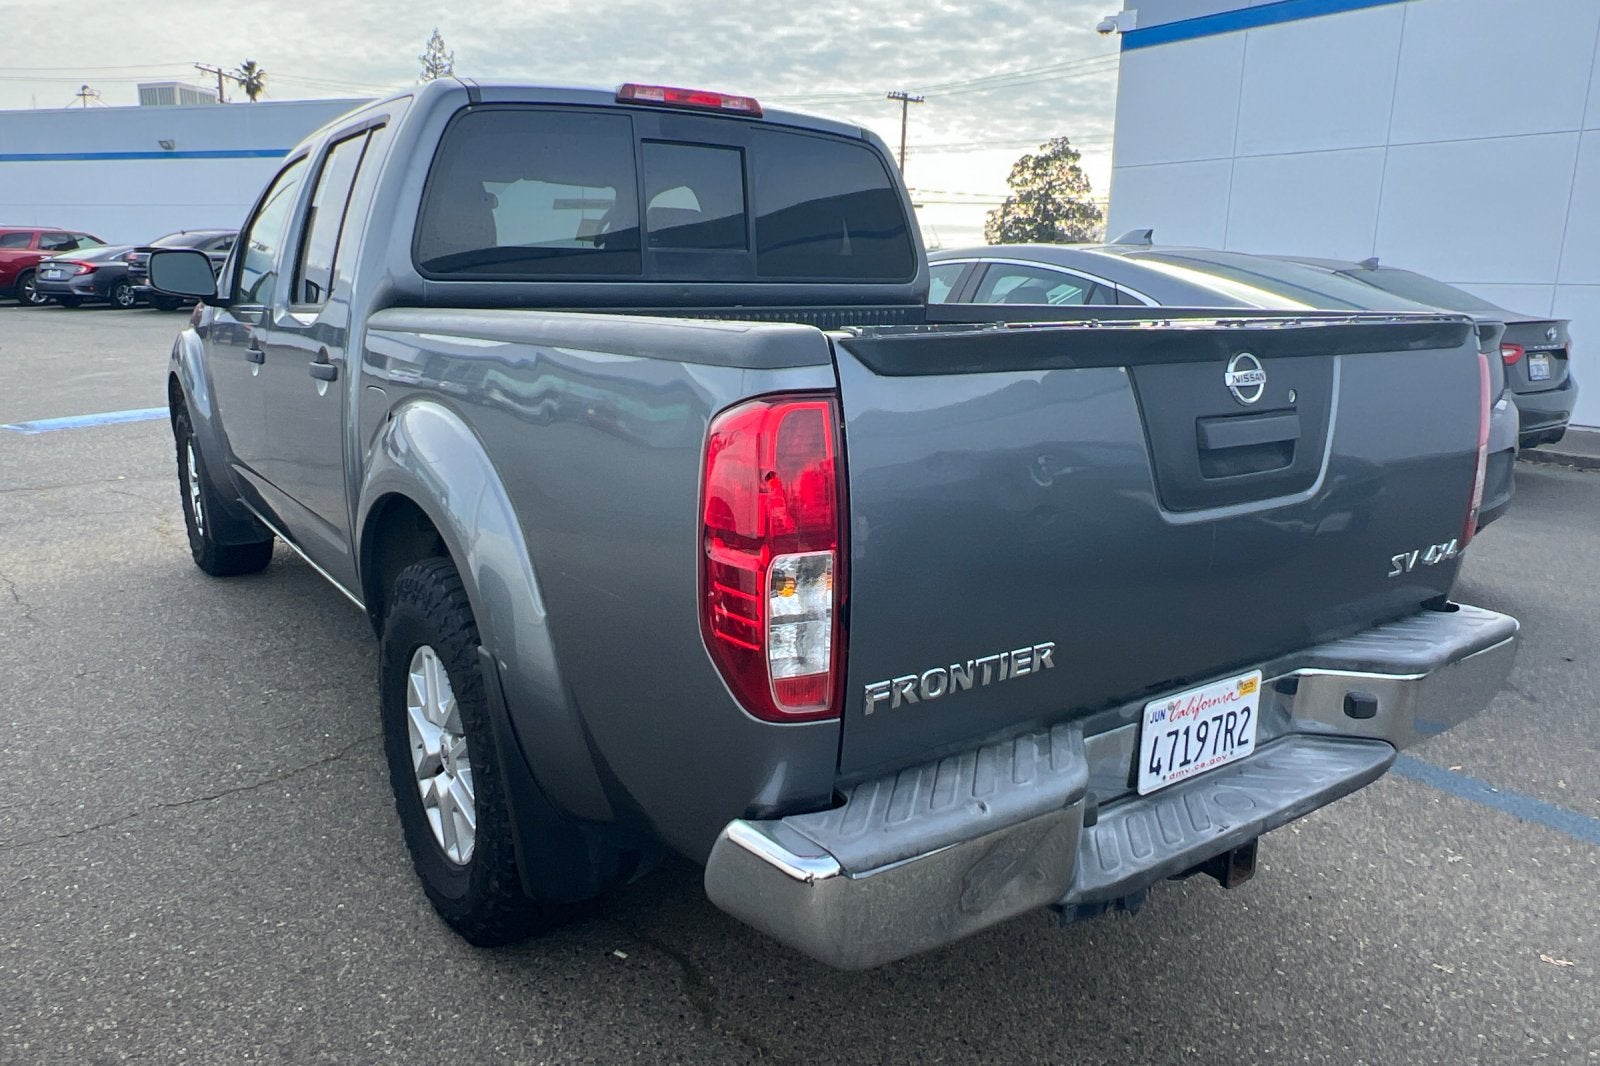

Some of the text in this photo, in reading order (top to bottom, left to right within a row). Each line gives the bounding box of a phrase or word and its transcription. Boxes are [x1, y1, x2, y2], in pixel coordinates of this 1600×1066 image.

[1232, 373, 1265, 383] NISSAN
[1387, 549, 1419, 577] SV
[863, 641, 1056, 715] FRONTIER
[1150, 708, 1166, 724] JUN
[1168, 690, 1239, 722] California
[1148, 706, 1251, 776] 47197R2
[1168, 753, 1228, 780] dmv.ca.gov
